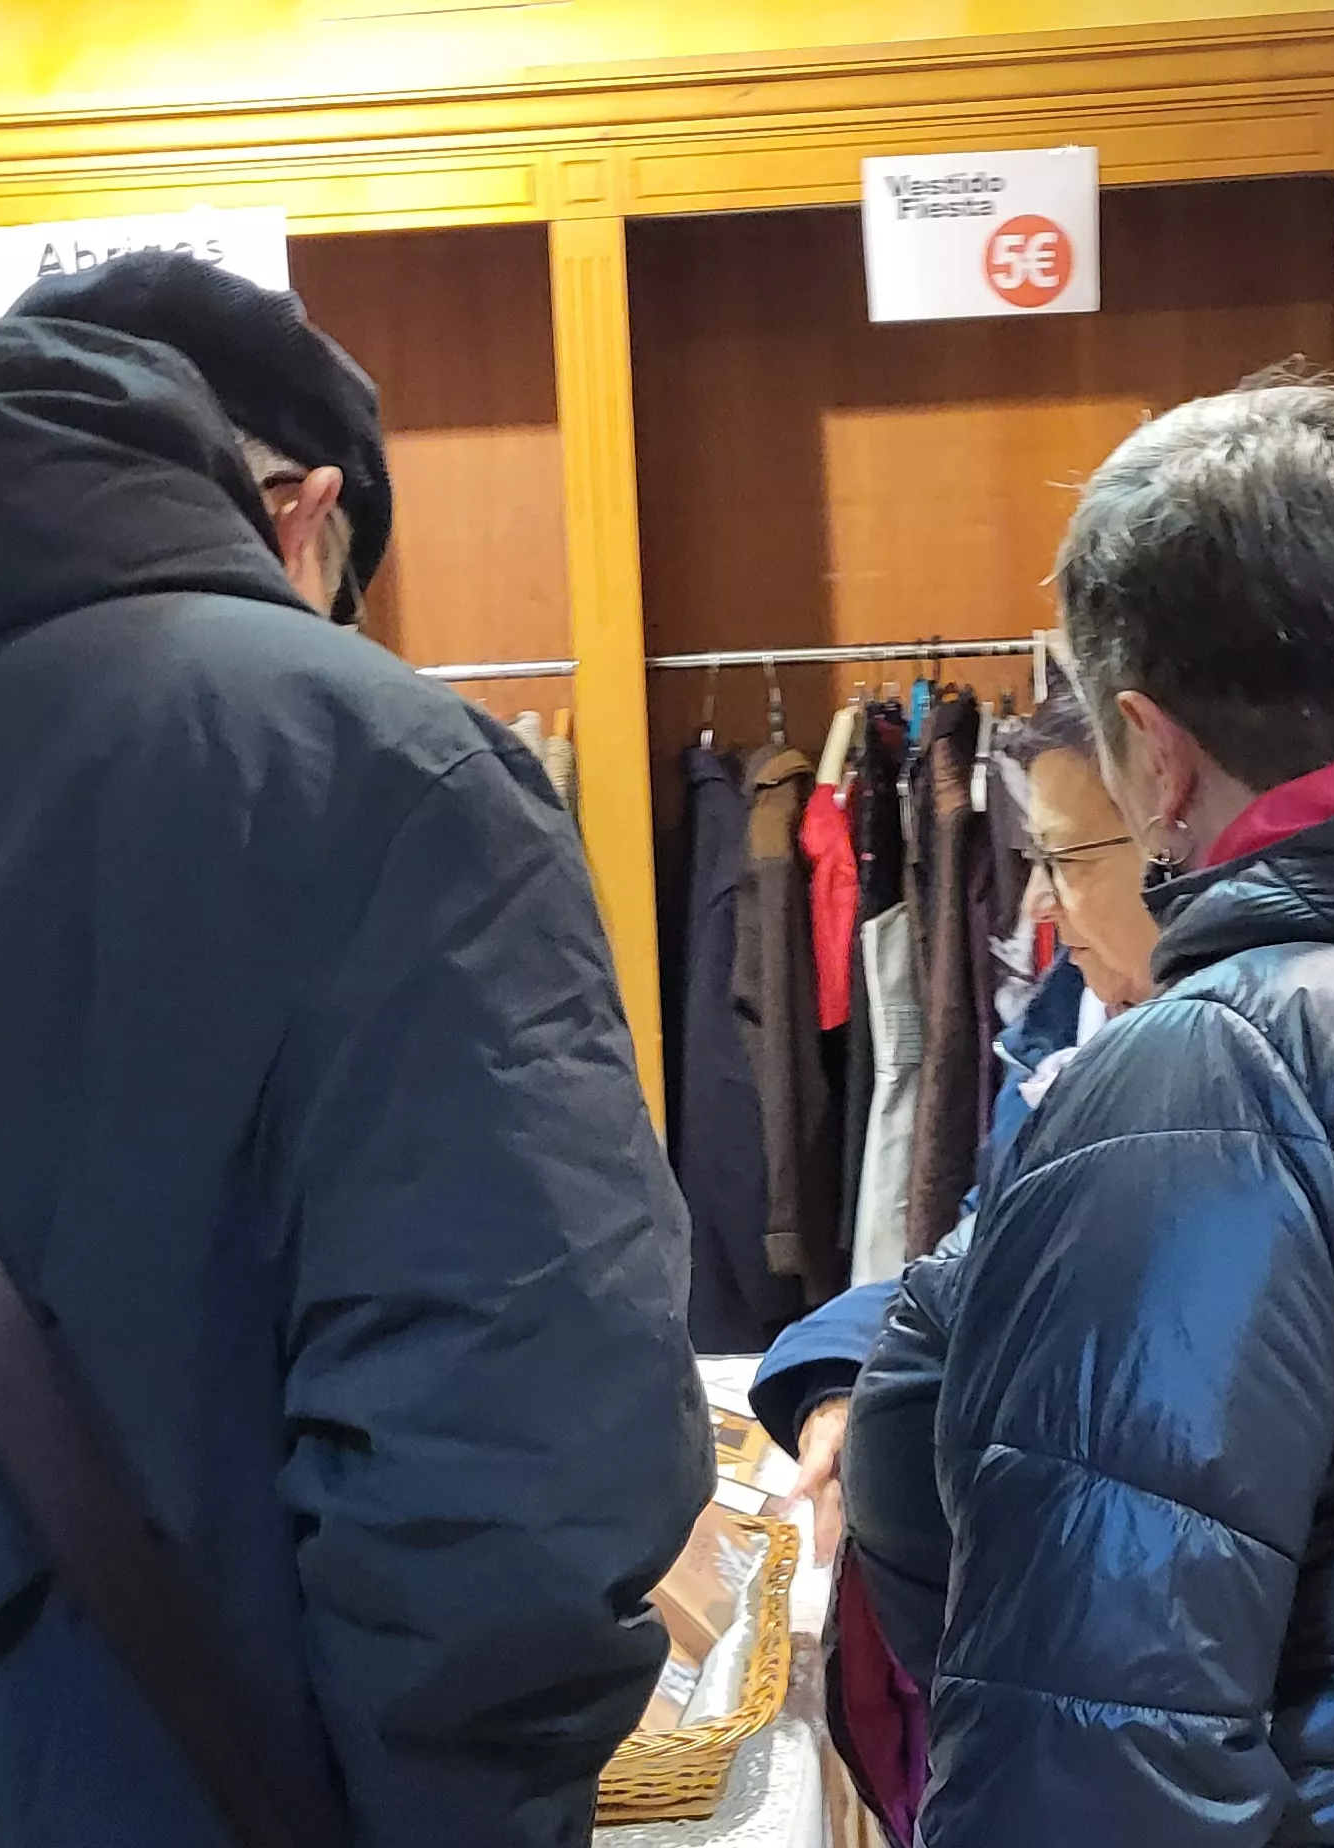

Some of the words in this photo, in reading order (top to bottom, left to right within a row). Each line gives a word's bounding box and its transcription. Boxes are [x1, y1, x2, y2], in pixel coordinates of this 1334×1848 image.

[883, 171, 1007, 197] Vestido
[896, 197, 997, 220] Fiesta
[38, 236, 224, 277] Abros
[991, 231, 1060, 289] 5€
